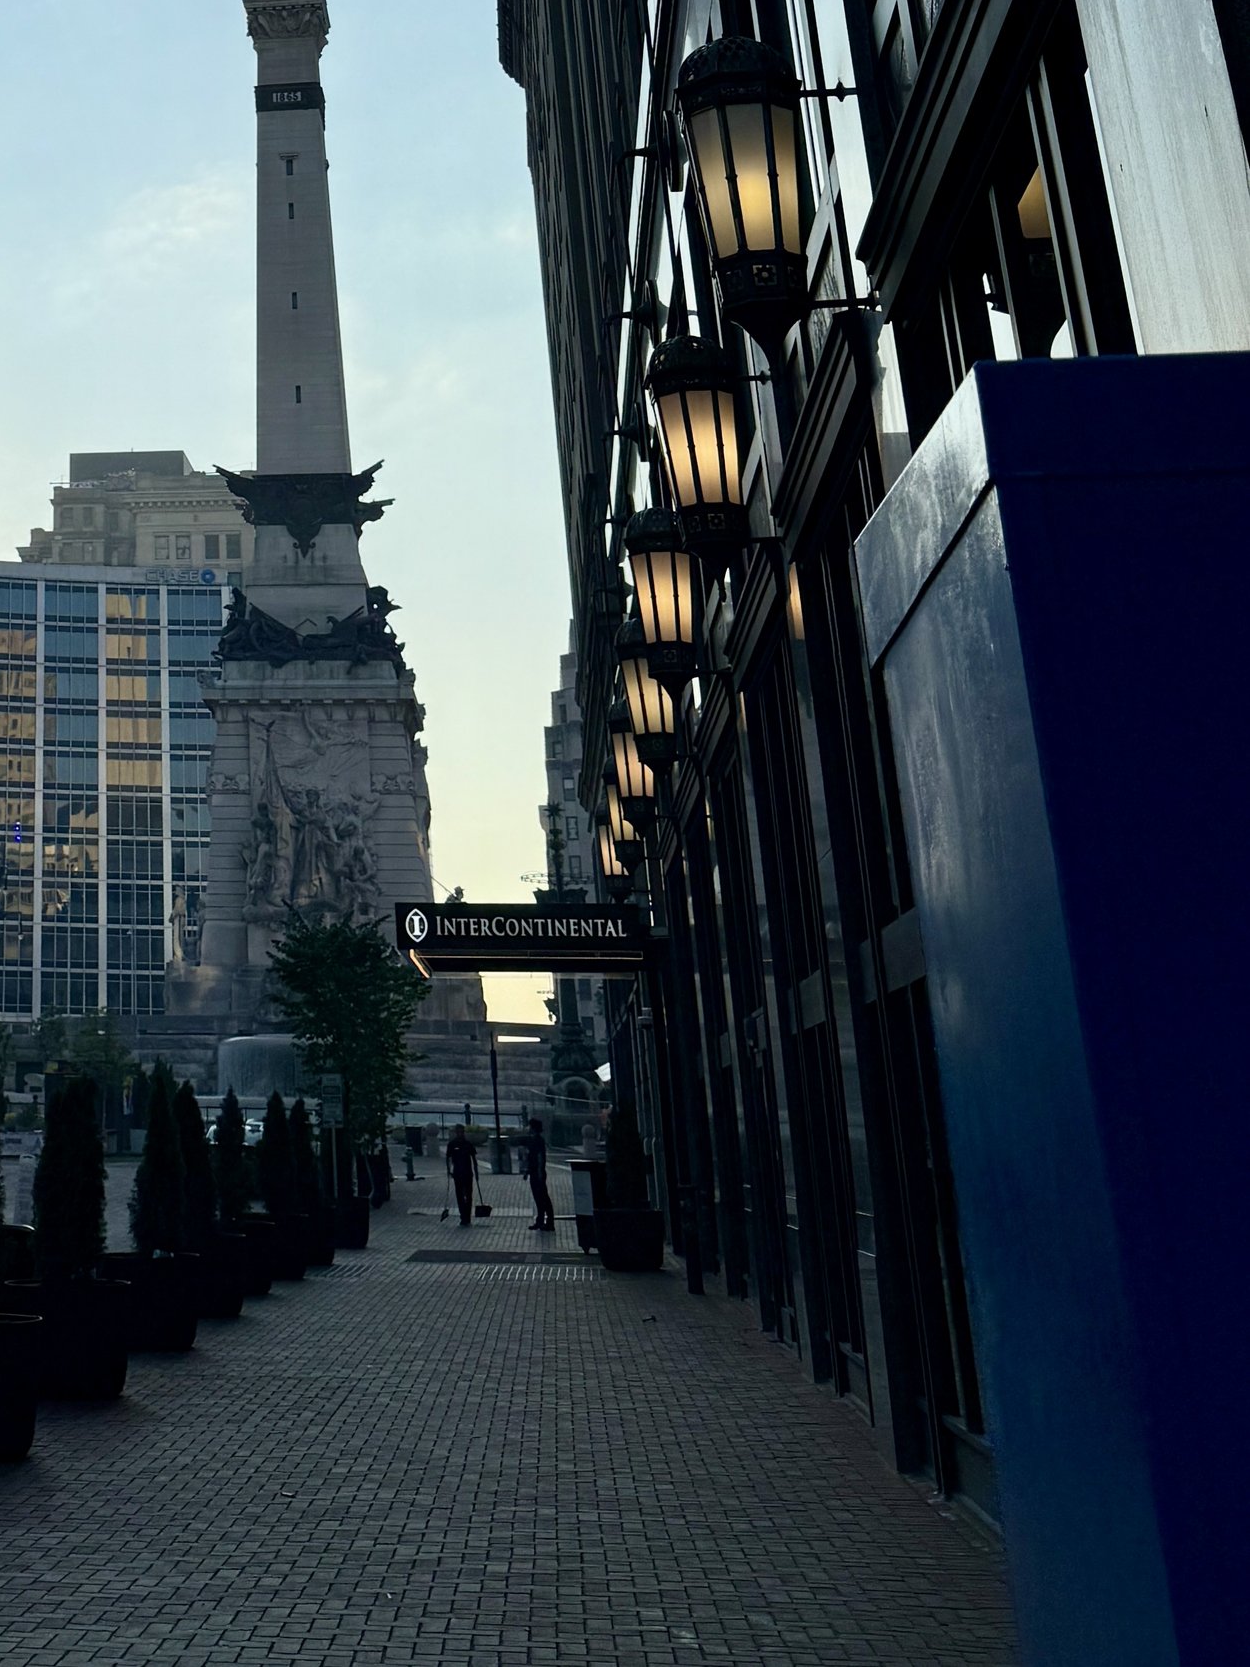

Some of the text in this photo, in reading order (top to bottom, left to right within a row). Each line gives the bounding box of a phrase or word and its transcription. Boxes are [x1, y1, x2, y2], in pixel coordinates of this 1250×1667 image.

[274, 91, 301, 102] 1865
[146, 569, 200, 583] CHASE
[435, 914, 628, 938] INTERCONTINENTAL
